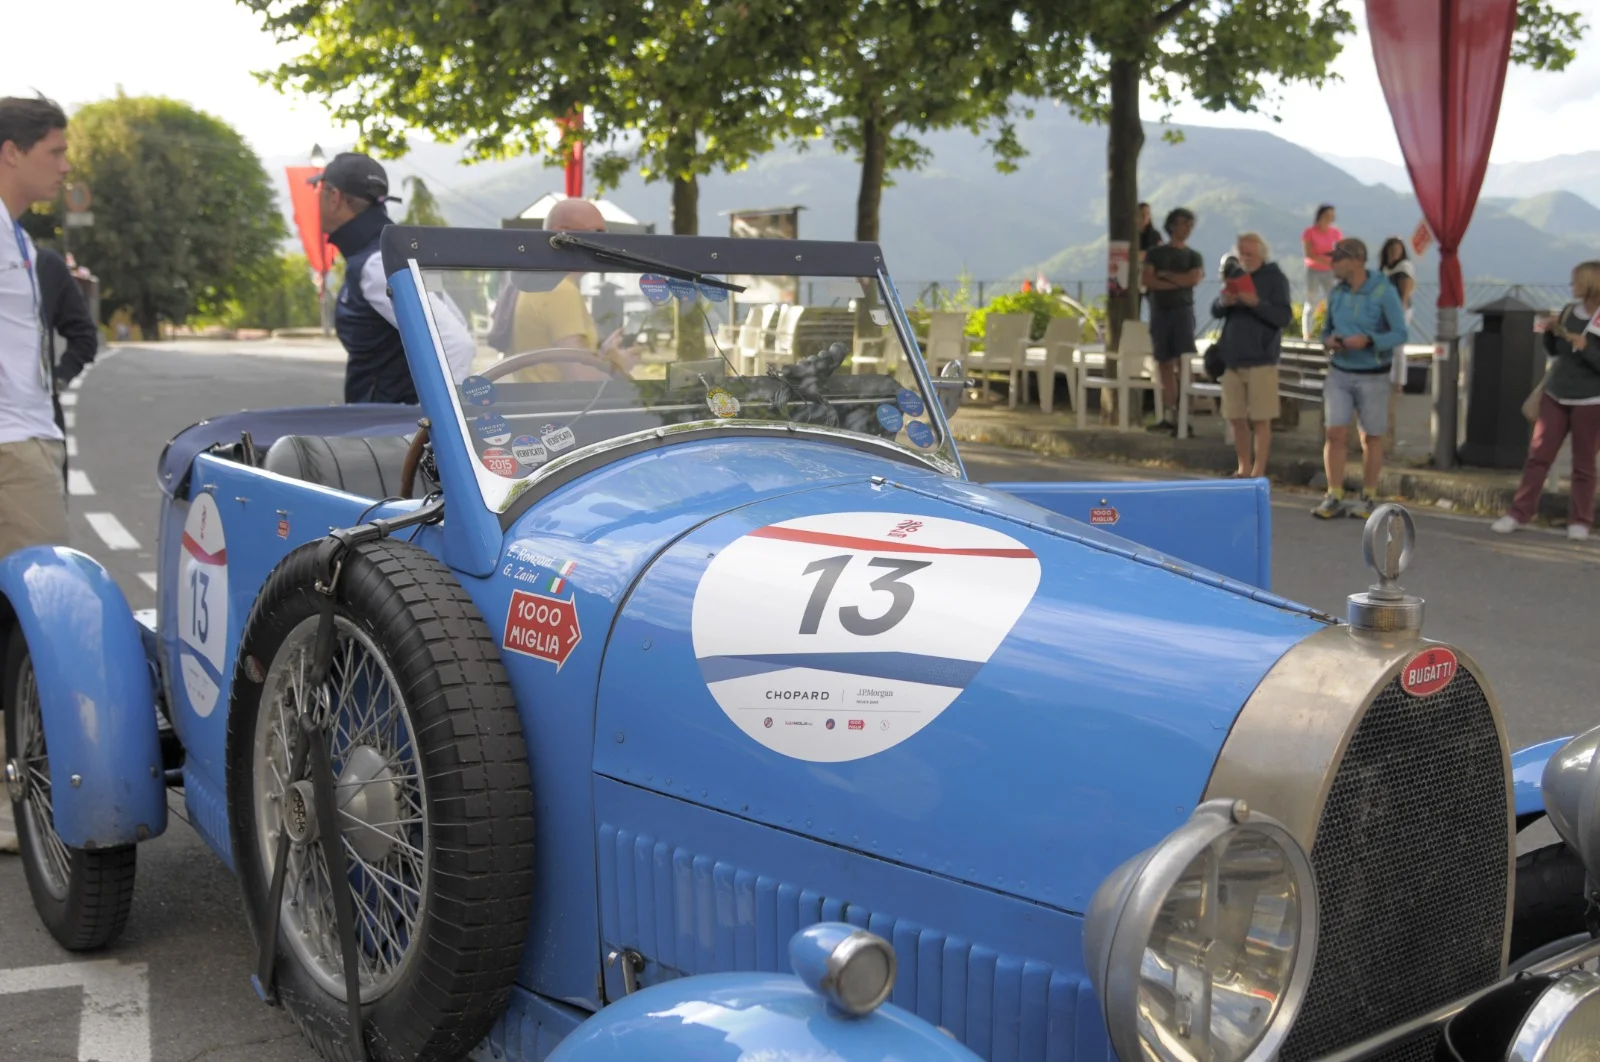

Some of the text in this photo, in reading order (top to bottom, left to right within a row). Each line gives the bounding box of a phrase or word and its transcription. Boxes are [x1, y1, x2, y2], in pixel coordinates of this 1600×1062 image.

[546, 430, 573, 446] VERIFICATO
[515, 447, 545, 458] VERIFICATO
[488, 459, 512, 470] 2015
[514, 566, 540, 584] Zaini
[798, 554, 933, 637] 13
[191, 569, 210, 644] 13
[518, 599, 562, 627] 1000
[509, 625, 560, 656] MIGLIA
[1408, 661, 1452, 686] BUGATTI
[765, 690, 830, 701] CHOPARD
